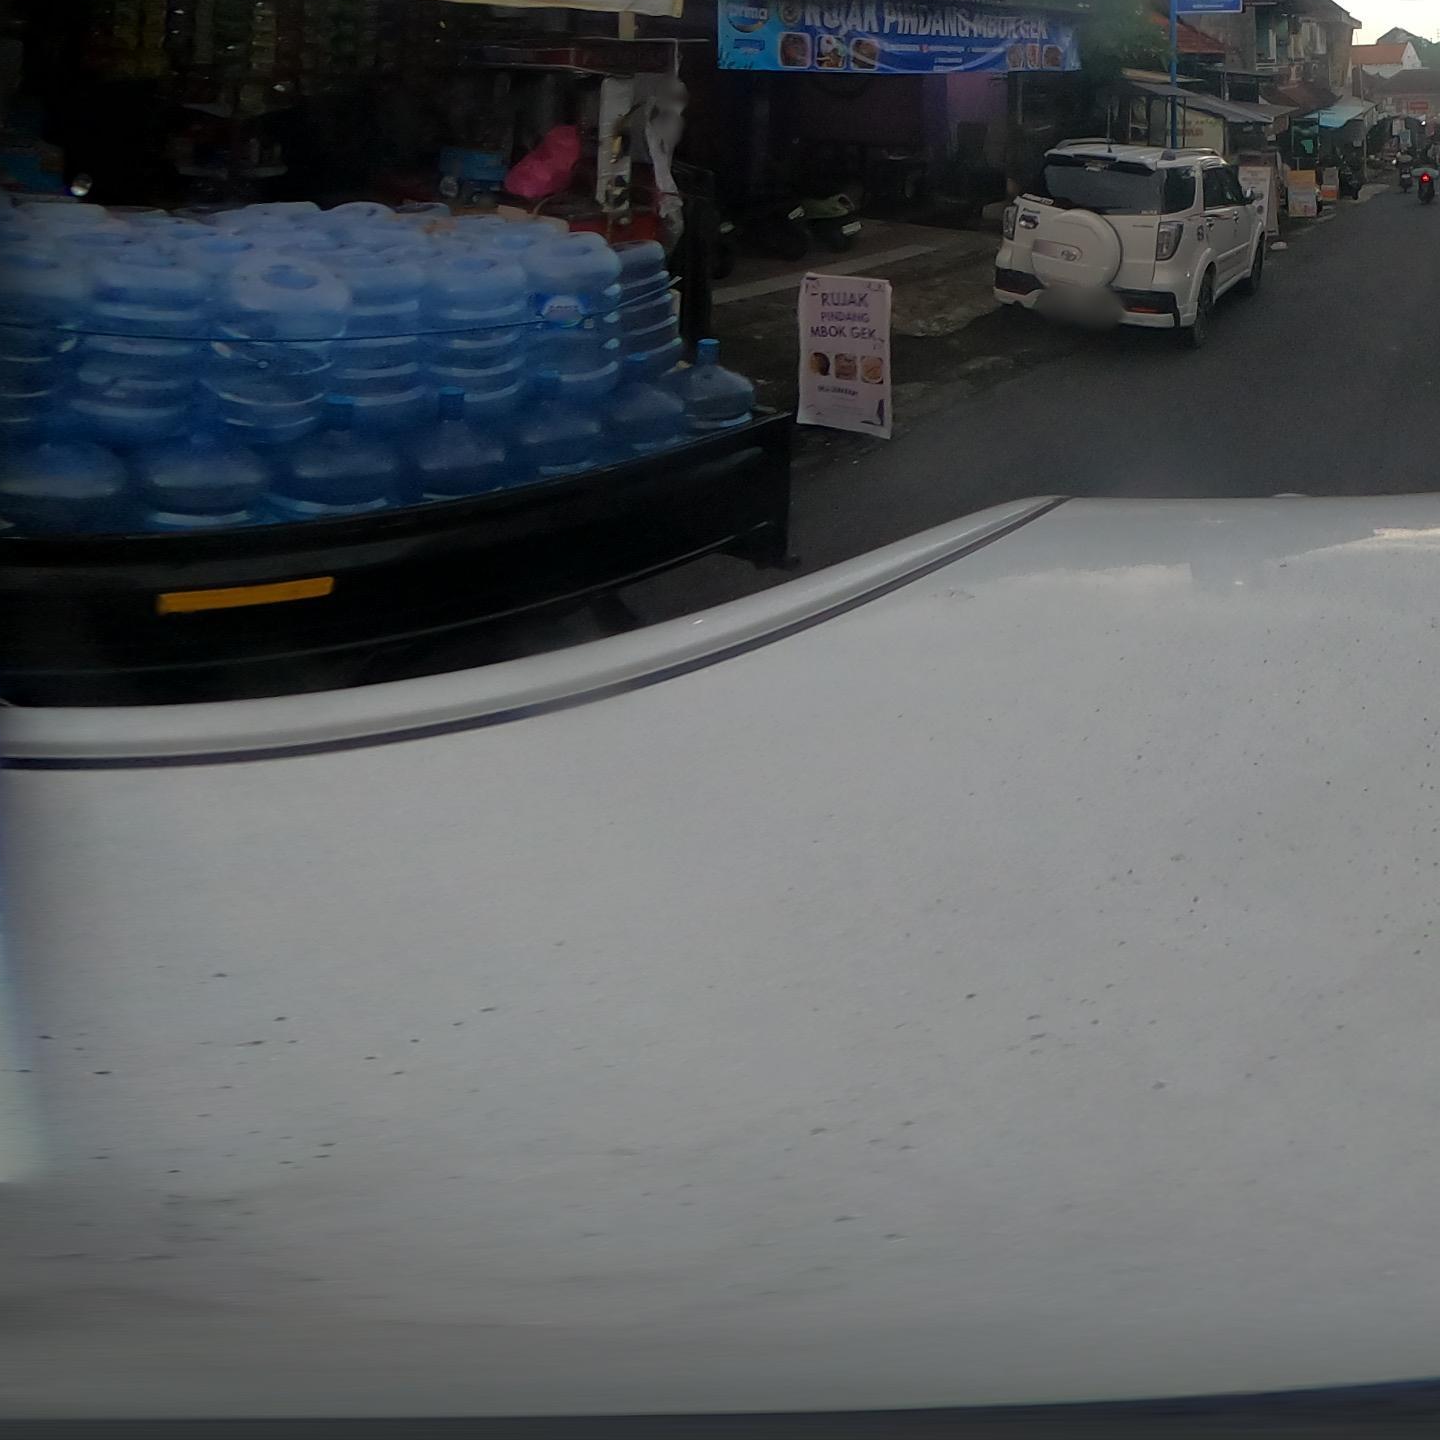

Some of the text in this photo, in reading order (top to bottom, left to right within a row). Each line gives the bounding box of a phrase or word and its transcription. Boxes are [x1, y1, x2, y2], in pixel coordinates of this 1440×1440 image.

[804, 0, 879, 36] RUJAK
[821, 292, 869, 307] RUJAK
[821, 311, 870, 323] PINDANG
[810, 326, 876, 340] MBOK GEK
